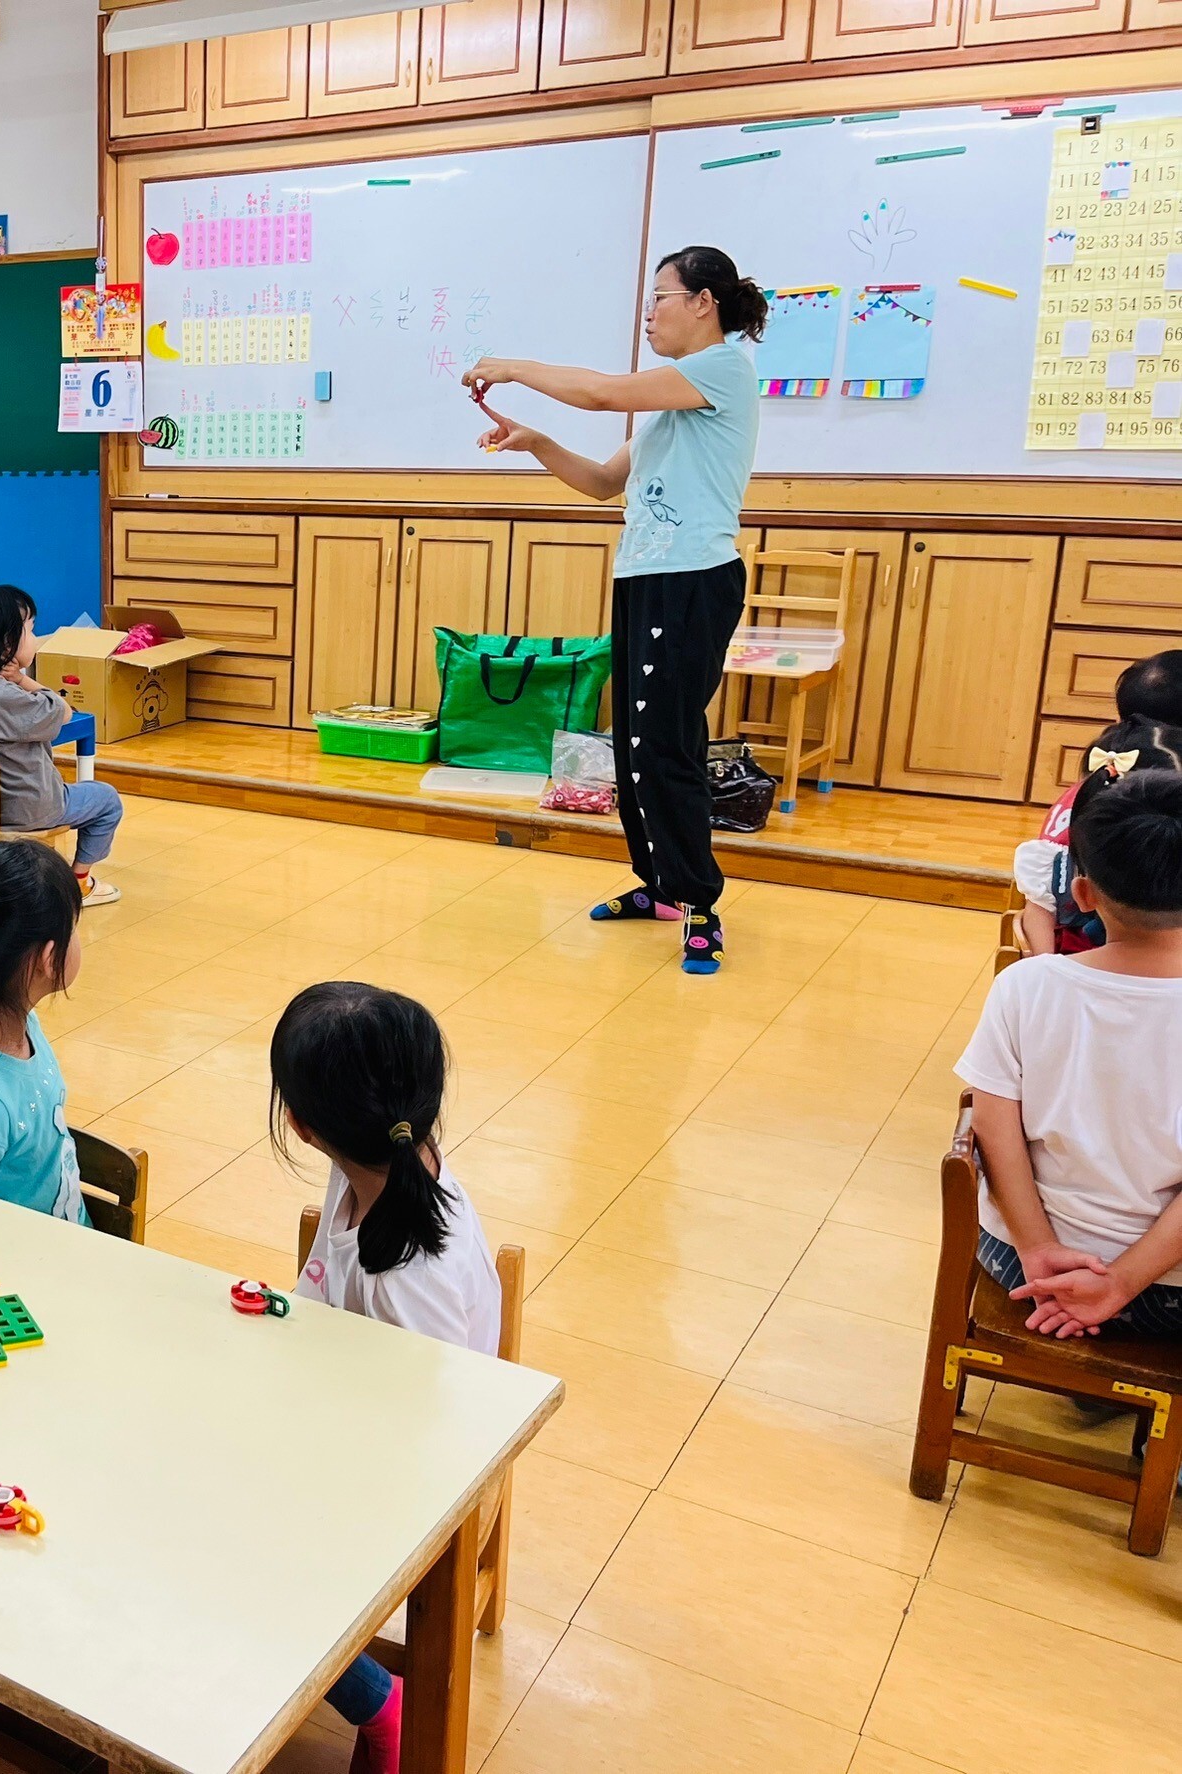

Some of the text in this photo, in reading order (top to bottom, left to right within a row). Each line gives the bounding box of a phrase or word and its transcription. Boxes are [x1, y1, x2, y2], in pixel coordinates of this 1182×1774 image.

[1068, 133, 1174, 156] 1 2 3 4 5
[1060, 166, 1176, 188] 11 12 14 15
[1055, 205, 1071, 220] 21
[1079, 204, 1098, 218] 22
[1103, 202, 1122, 217] 23
[1128, 201, 1146, 215] 24
[1153, 199, 1172, 214] 25
[1076, 235, 1095, 250] 32
[1100, 234, 1119, 249] 33
[1125, 233, 1143, 248] 34
[1150, 231, 1169, 246] 35
[1049, 264, 1166, 283] 41 42 43 44 45
[1047, 300, 1063, 314] 51
[1070, 299, 1089, 313] 52
[1094, 298, 1113, 312] 53
[1118, 297, 1137, 311] 54
[1143, 296, 1162, 310] 55
[1044, 327, 1182, 345] 61 63 64 66
[126, 371, 131, 379] 8
[1042, 358, 1180, 375] 71 72 73 75 76
[92, 370, 112, 407] 6
[1038, 391, 1152, 406] 81 82 83 84 85
[85, 408, 116, 417] 星期二
[1035, 422, 1051, 436] 91
[1058, 422, 1077, 436] 92
[1106, 422, 1123, 436] 94
[1130, 422, 1148, 436] 95
[1154, 421, 1173, 435] 96
